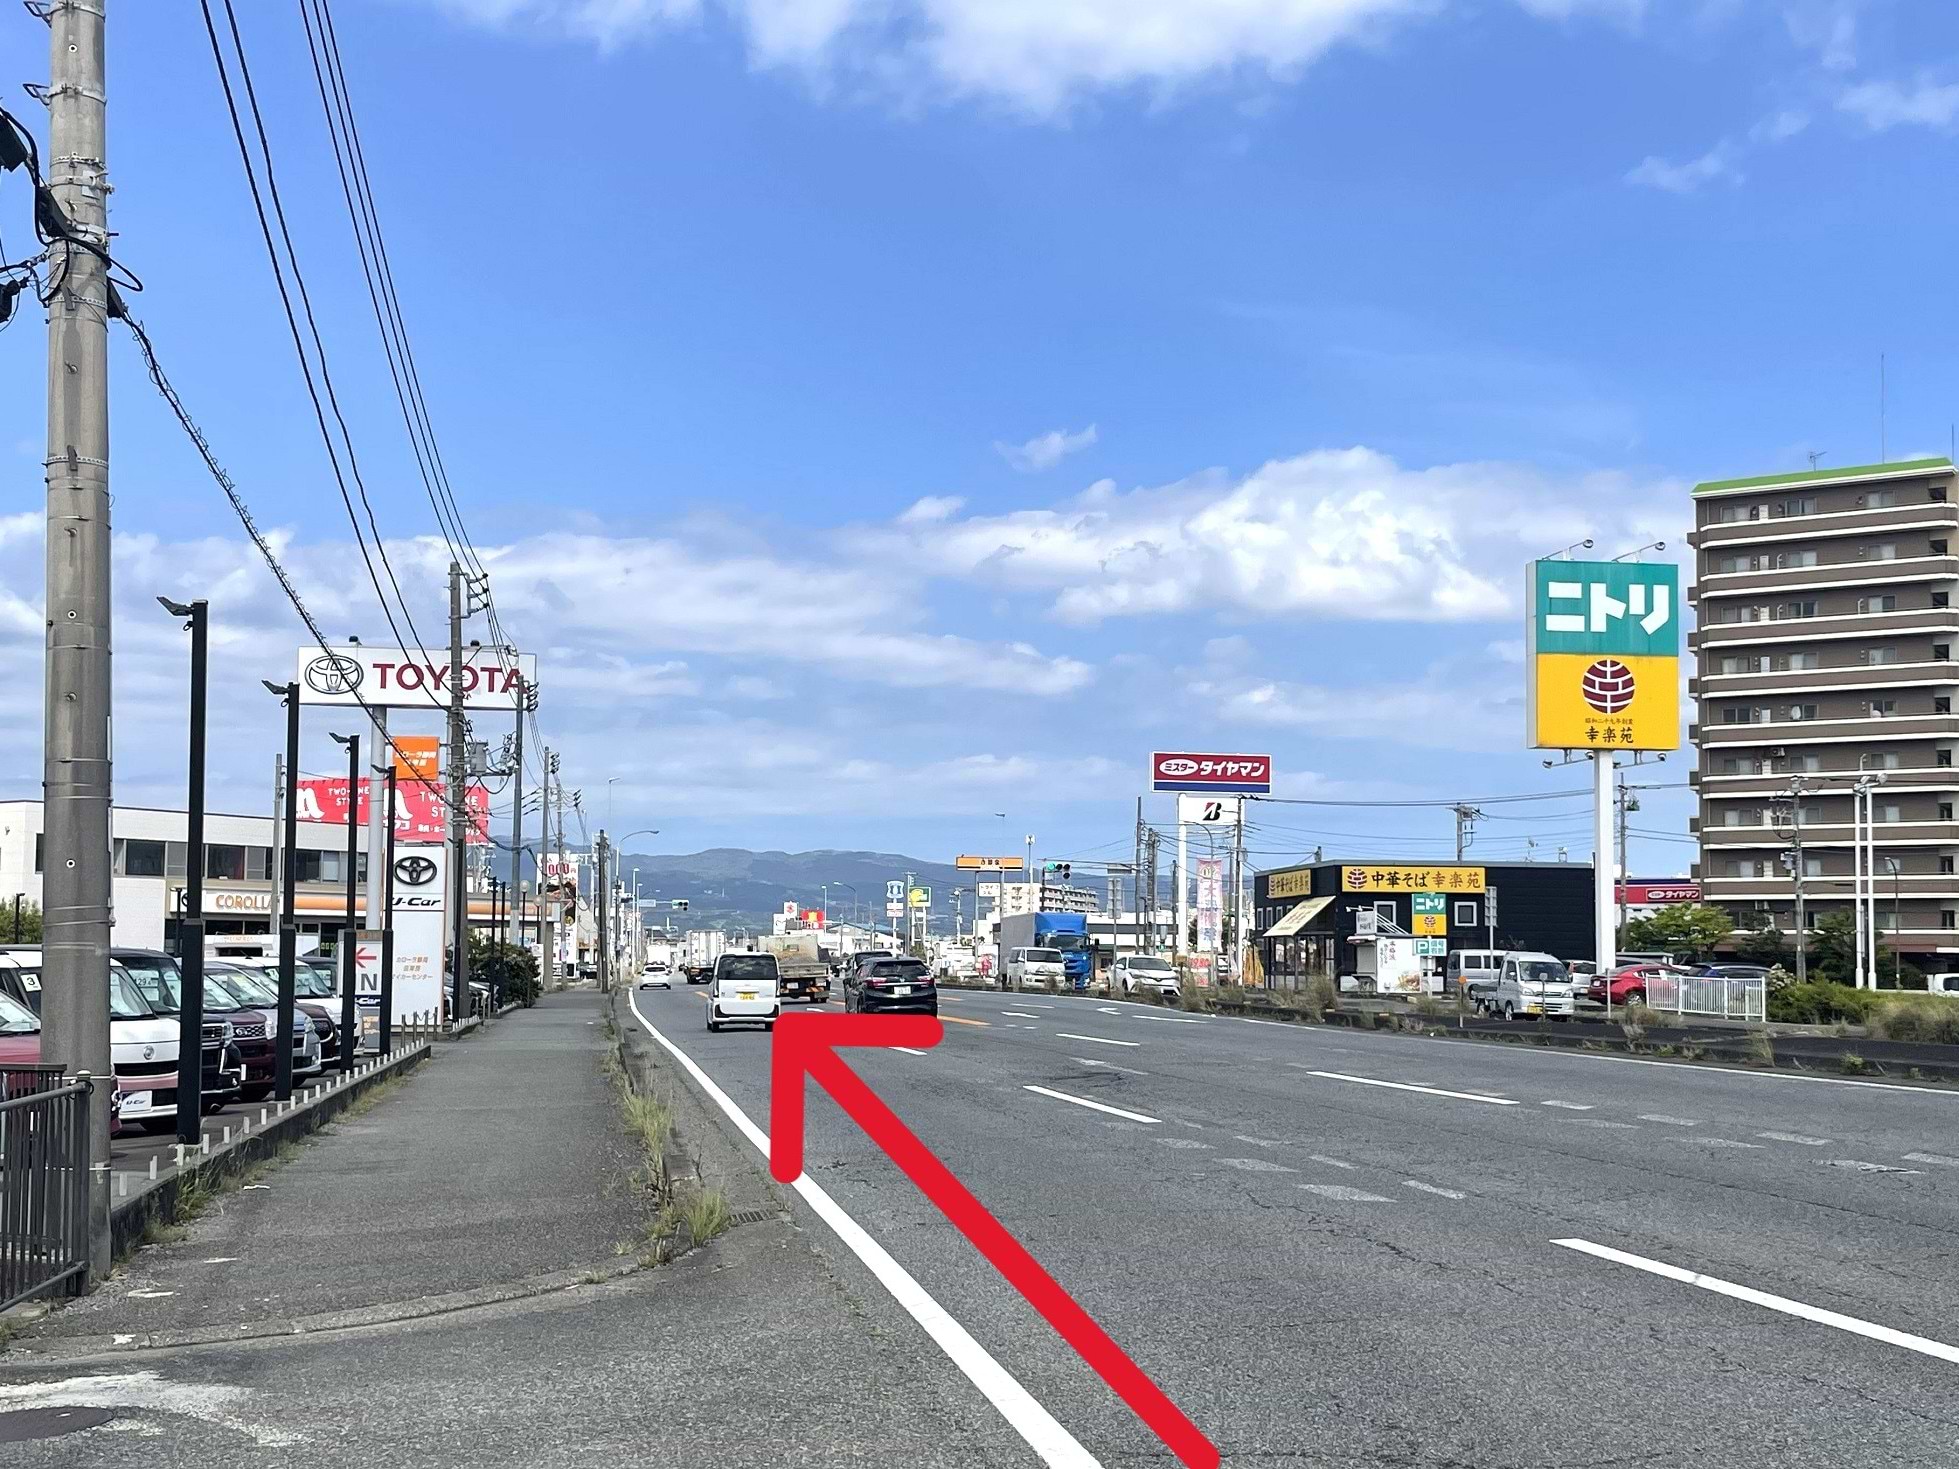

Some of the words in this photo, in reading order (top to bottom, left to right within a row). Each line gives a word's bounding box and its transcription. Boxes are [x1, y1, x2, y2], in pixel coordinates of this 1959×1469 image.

[1546, 581, 1669, 635] ニトリ
[373, 663, 528, 693] TOYOTA
[1585, 717, 1633, 725] 昭和二十九年創業
[1585, 726, 1634, 743] 幸楽苑
[1164, 762, 1194, 773] ミスター
[1200, 760, 1265, 777] タイヤマン
[1666, 890, 1699, 898] タイヤマン
[1415, 898, 1445, 911] ニトリ
[1417, 941, 1429, 954] P
[26, 977, 36, 986] 3
